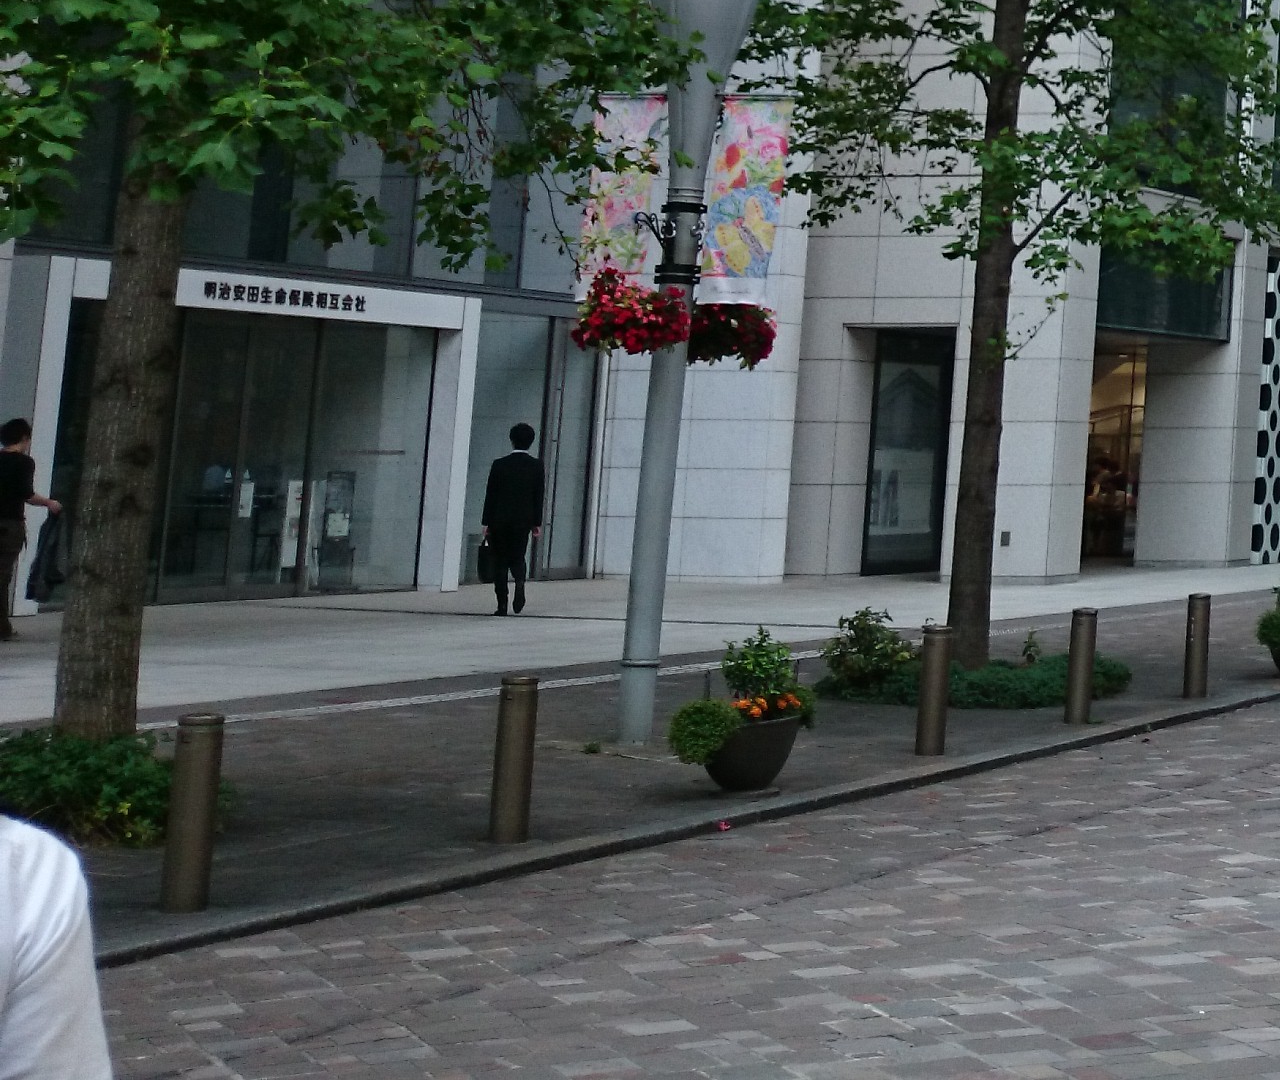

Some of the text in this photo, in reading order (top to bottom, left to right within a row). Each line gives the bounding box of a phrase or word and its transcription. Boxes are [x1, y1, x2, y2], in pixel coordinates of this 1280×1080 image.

[204, 281, 367, 312] 明治安田生命保険相互会社
